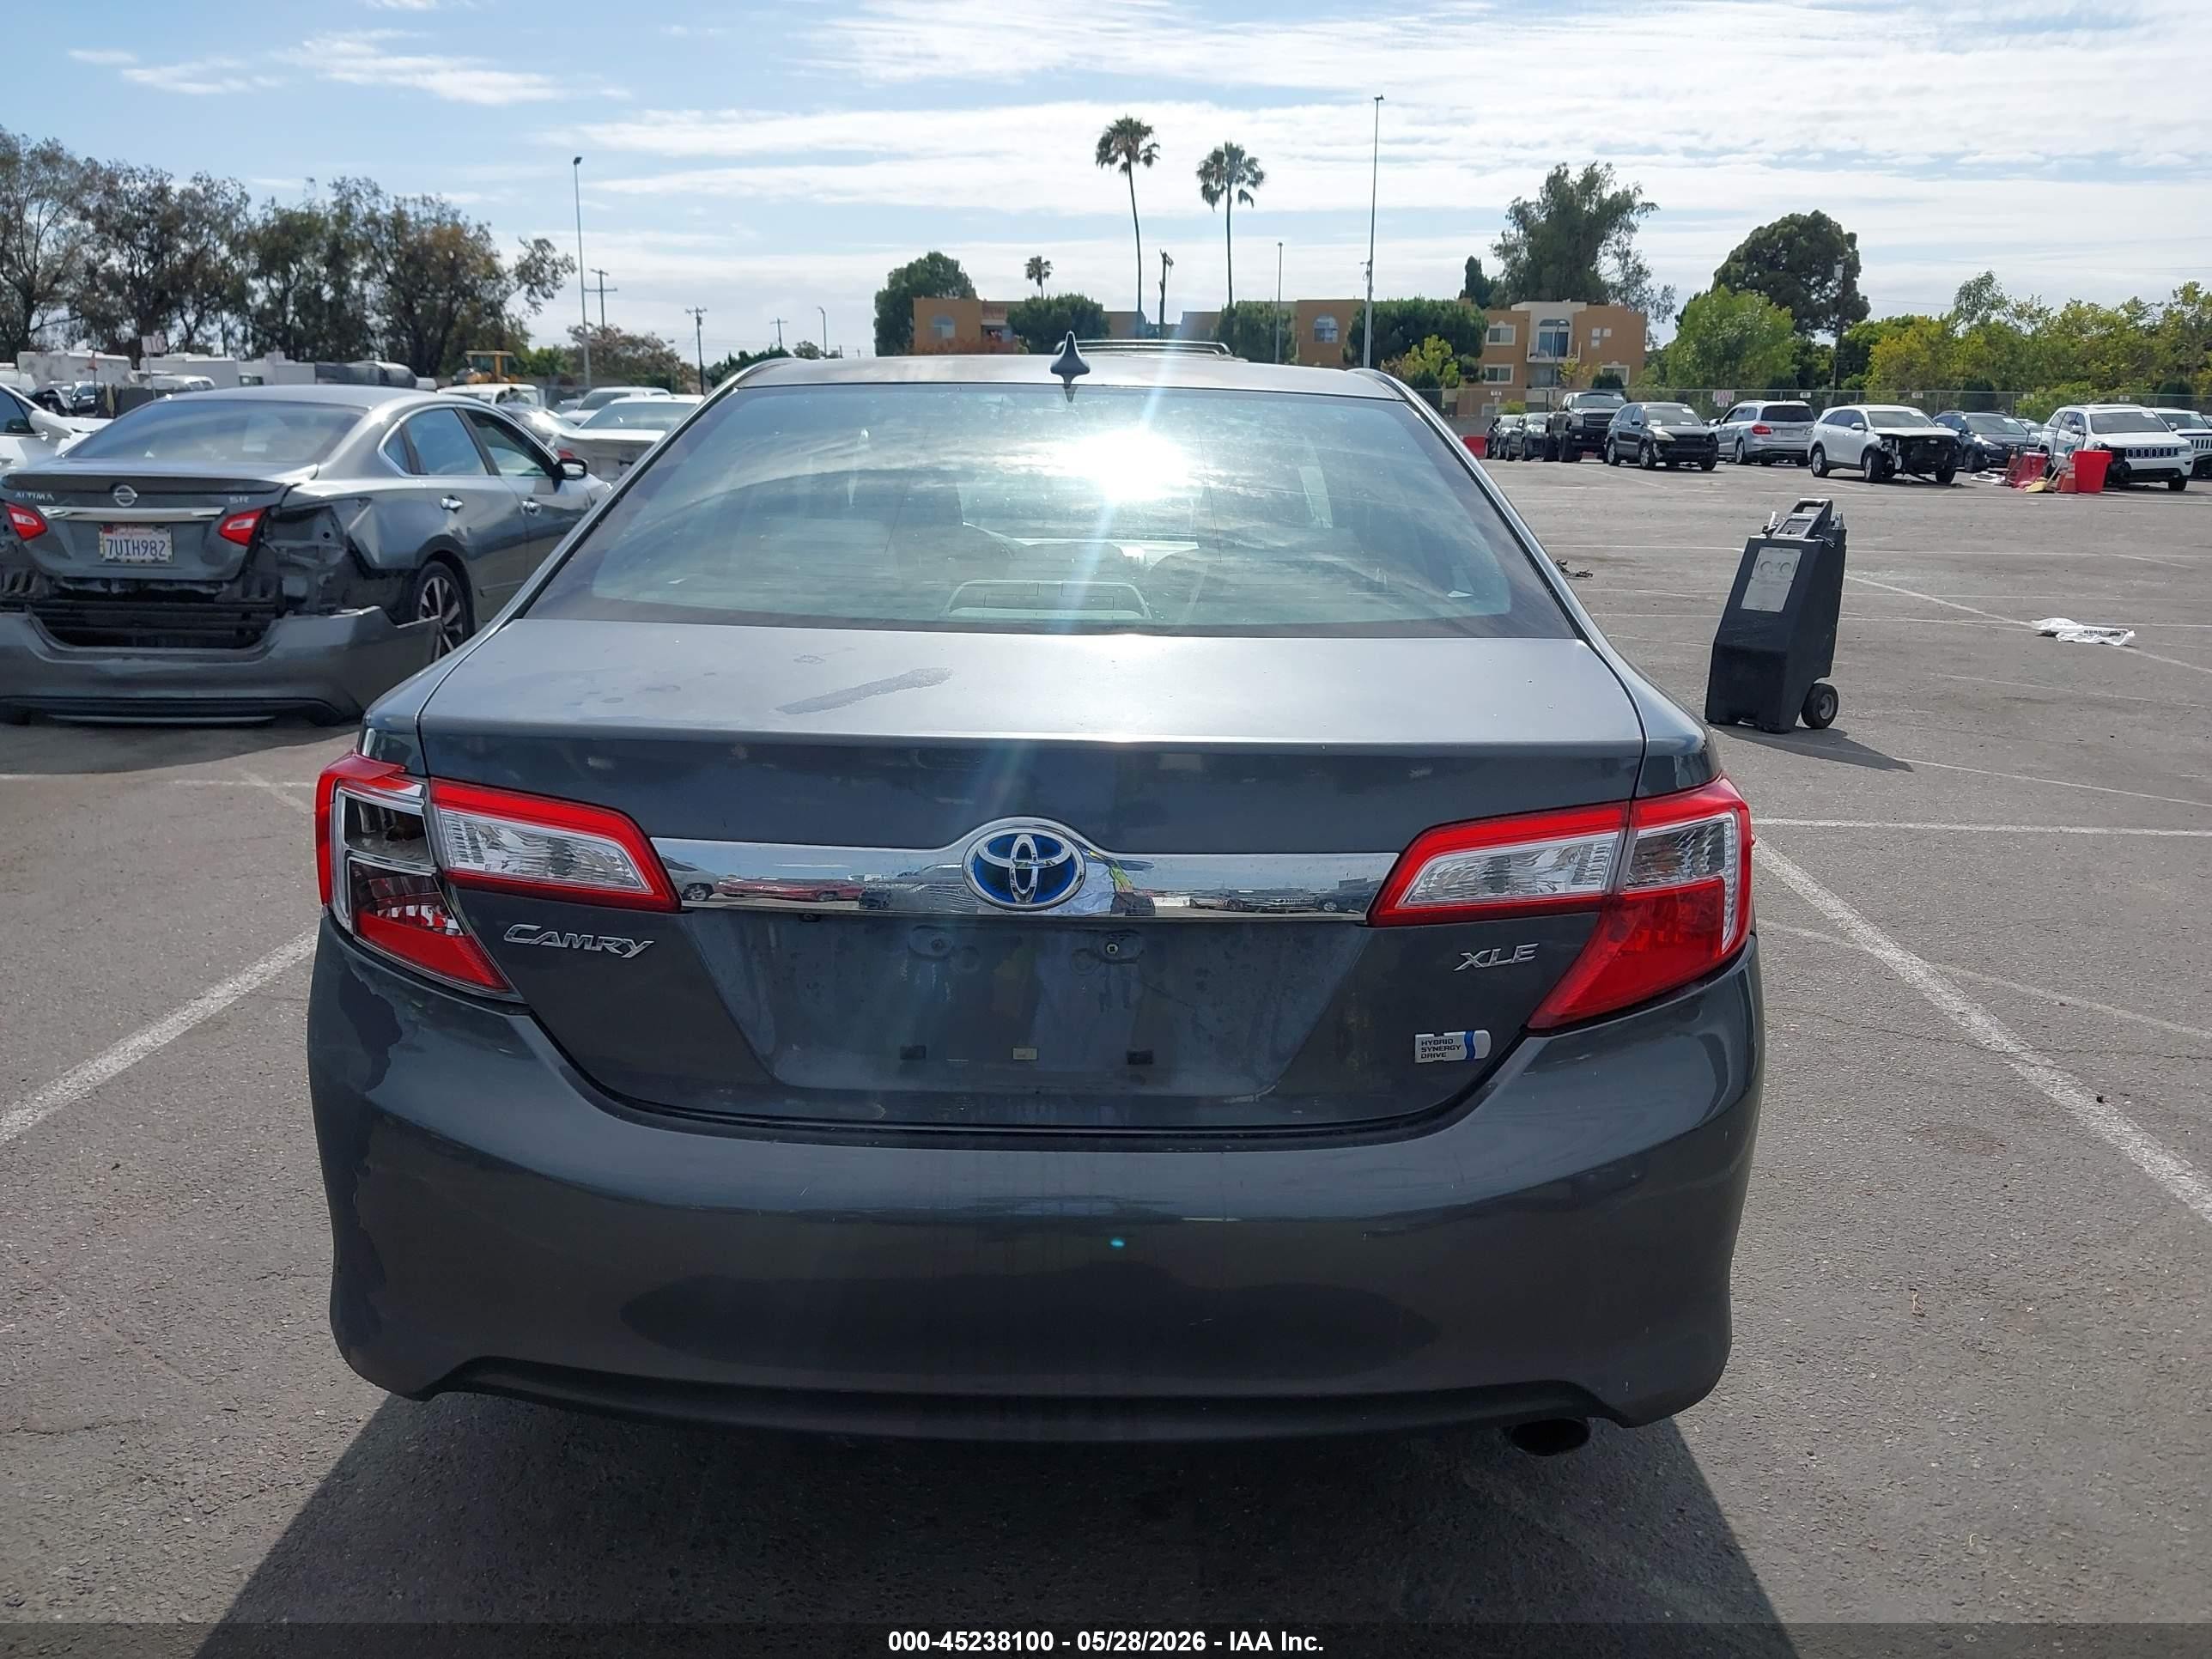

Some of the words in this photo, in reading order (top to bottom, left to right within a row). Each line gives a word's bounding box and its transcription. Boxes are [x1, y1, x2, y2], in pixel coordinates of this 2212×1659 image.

[106, 539, 167, 556] 7UIH982
[503, 923, 655, 958] CAMRY
[1453, 943, 1540, 972] XLE
